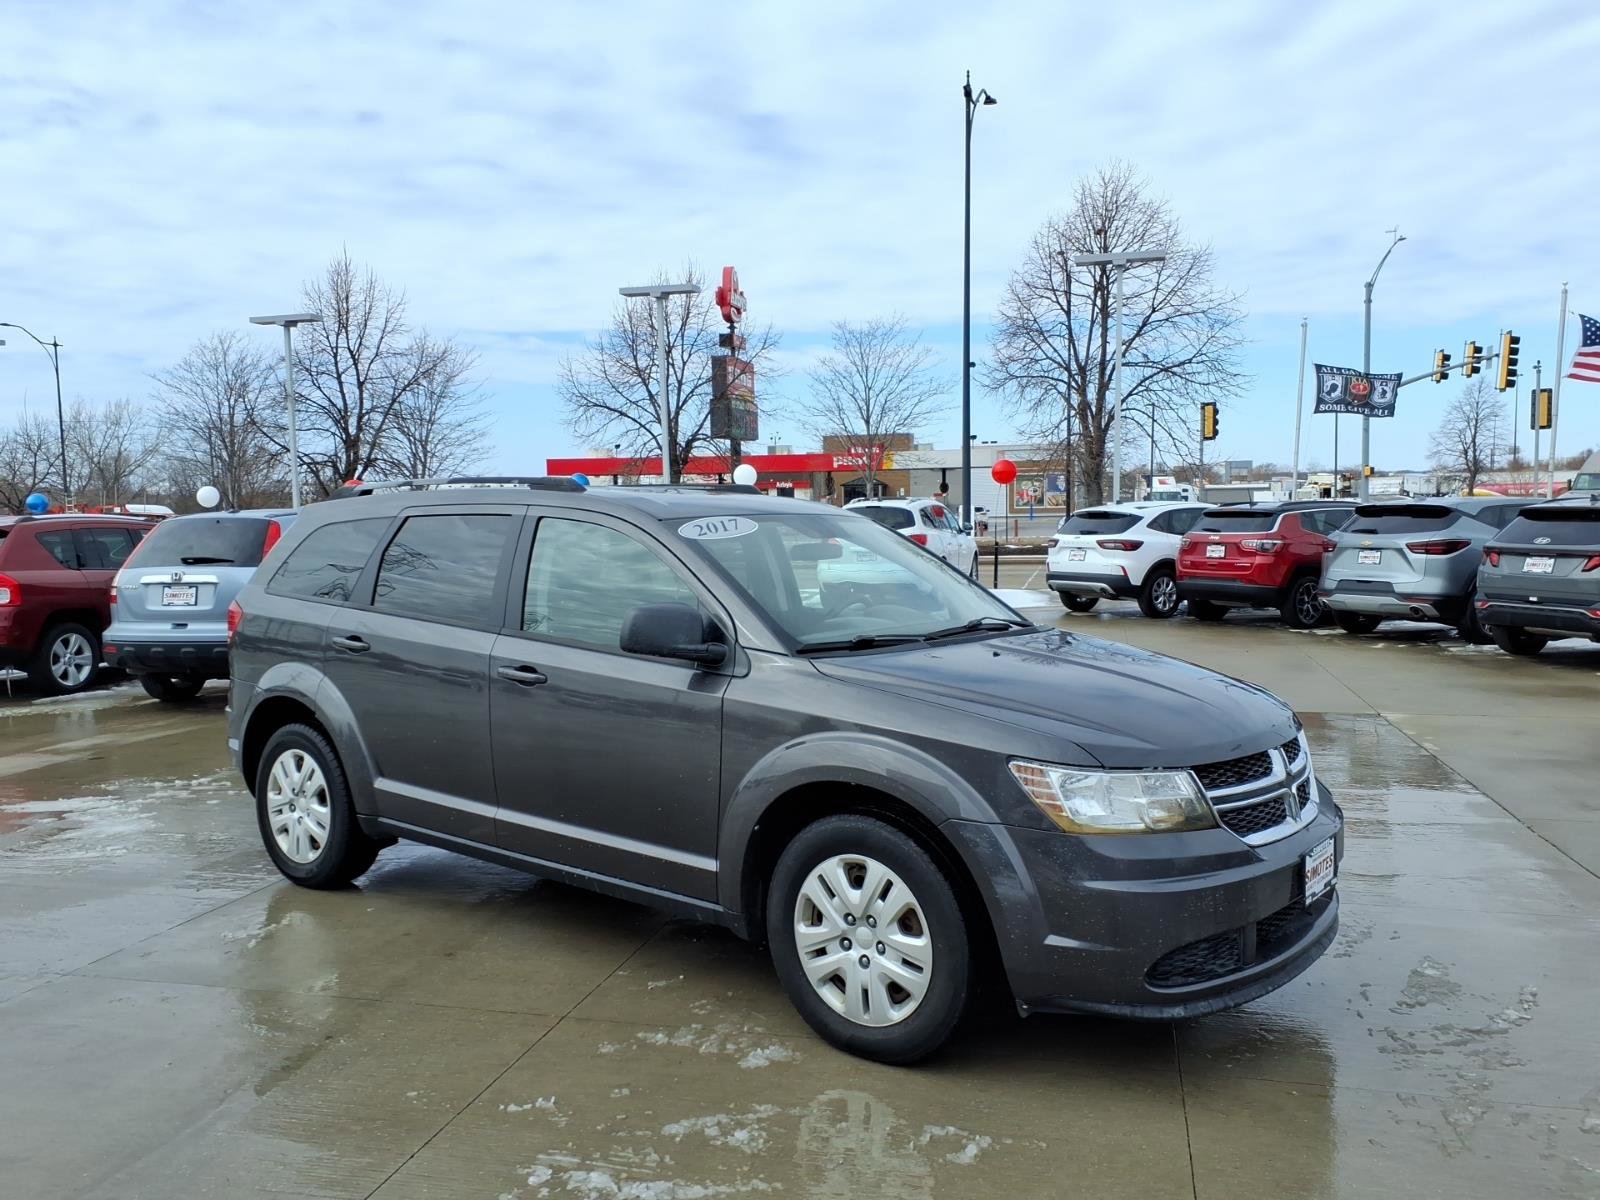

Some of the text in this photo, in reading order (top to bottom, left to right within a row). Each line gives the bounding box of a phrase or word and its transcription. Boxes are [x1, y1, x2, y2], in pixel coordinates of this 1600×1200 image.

[1320, 366, 1340, 374] ALL
[1351, 377, 1368, 385] KIA
[1319, 404, 1390, 416] SOME GIVE ALL
[693, 518, 738, 536] 2017
[1305, 853, 1333, 883] SIMOTES
